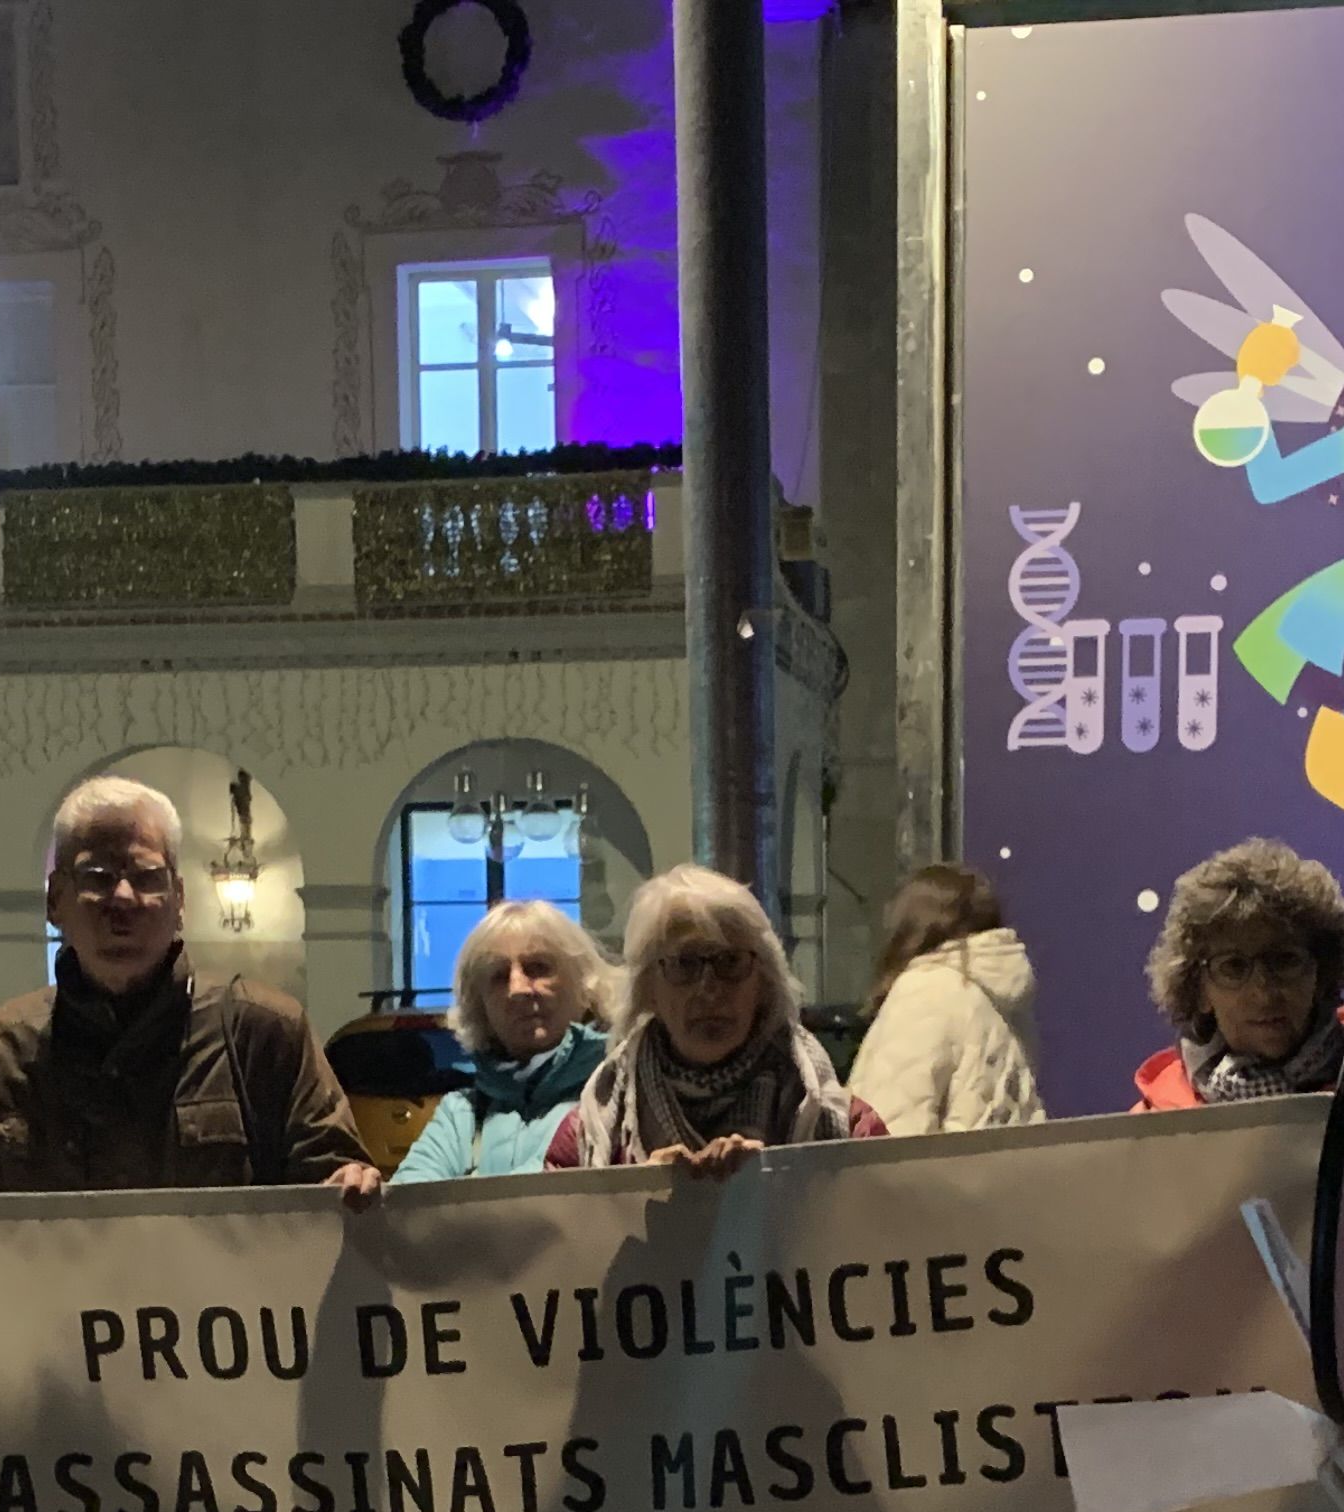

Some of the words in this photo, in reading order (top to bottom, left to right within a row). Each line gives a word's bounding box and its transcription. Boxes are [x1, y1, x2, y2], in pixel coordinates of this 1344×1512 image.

[79, 1304, 309, 1384] PROU
[355, 1299, 468, 1380] DE
[509, 1247, 1035, 1369] VIOLÈNCIES
[650, 1386, 1265, 1511] MASCLIST
